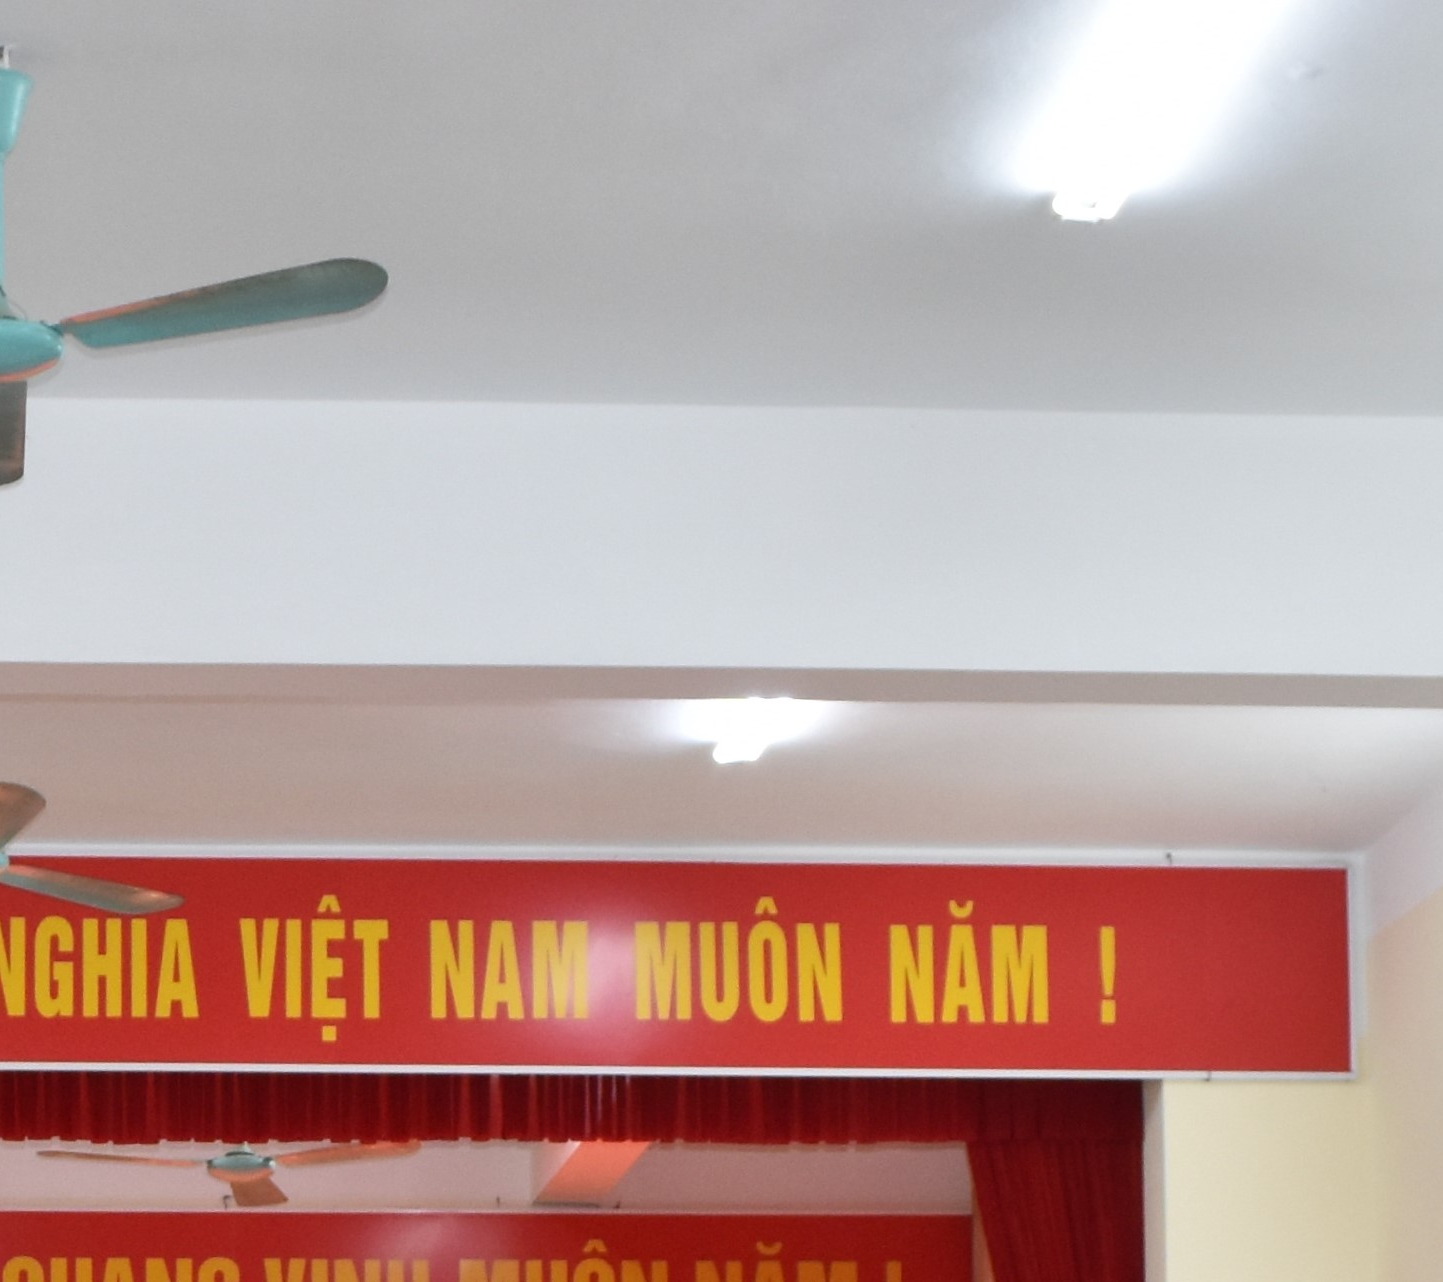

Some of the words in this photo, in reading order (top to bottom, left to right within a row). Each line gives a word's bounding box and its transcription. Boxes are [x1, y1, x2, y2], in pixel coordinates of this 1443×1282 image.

[239, 894, 389, 1043] VIỆT
[430, 918, 590, 1021] NAM
[635, 895, 844, 1023] MUÔN
[889, 899, 1050, 1025] NĂM
[1099, 926, 1118, 1025] !
